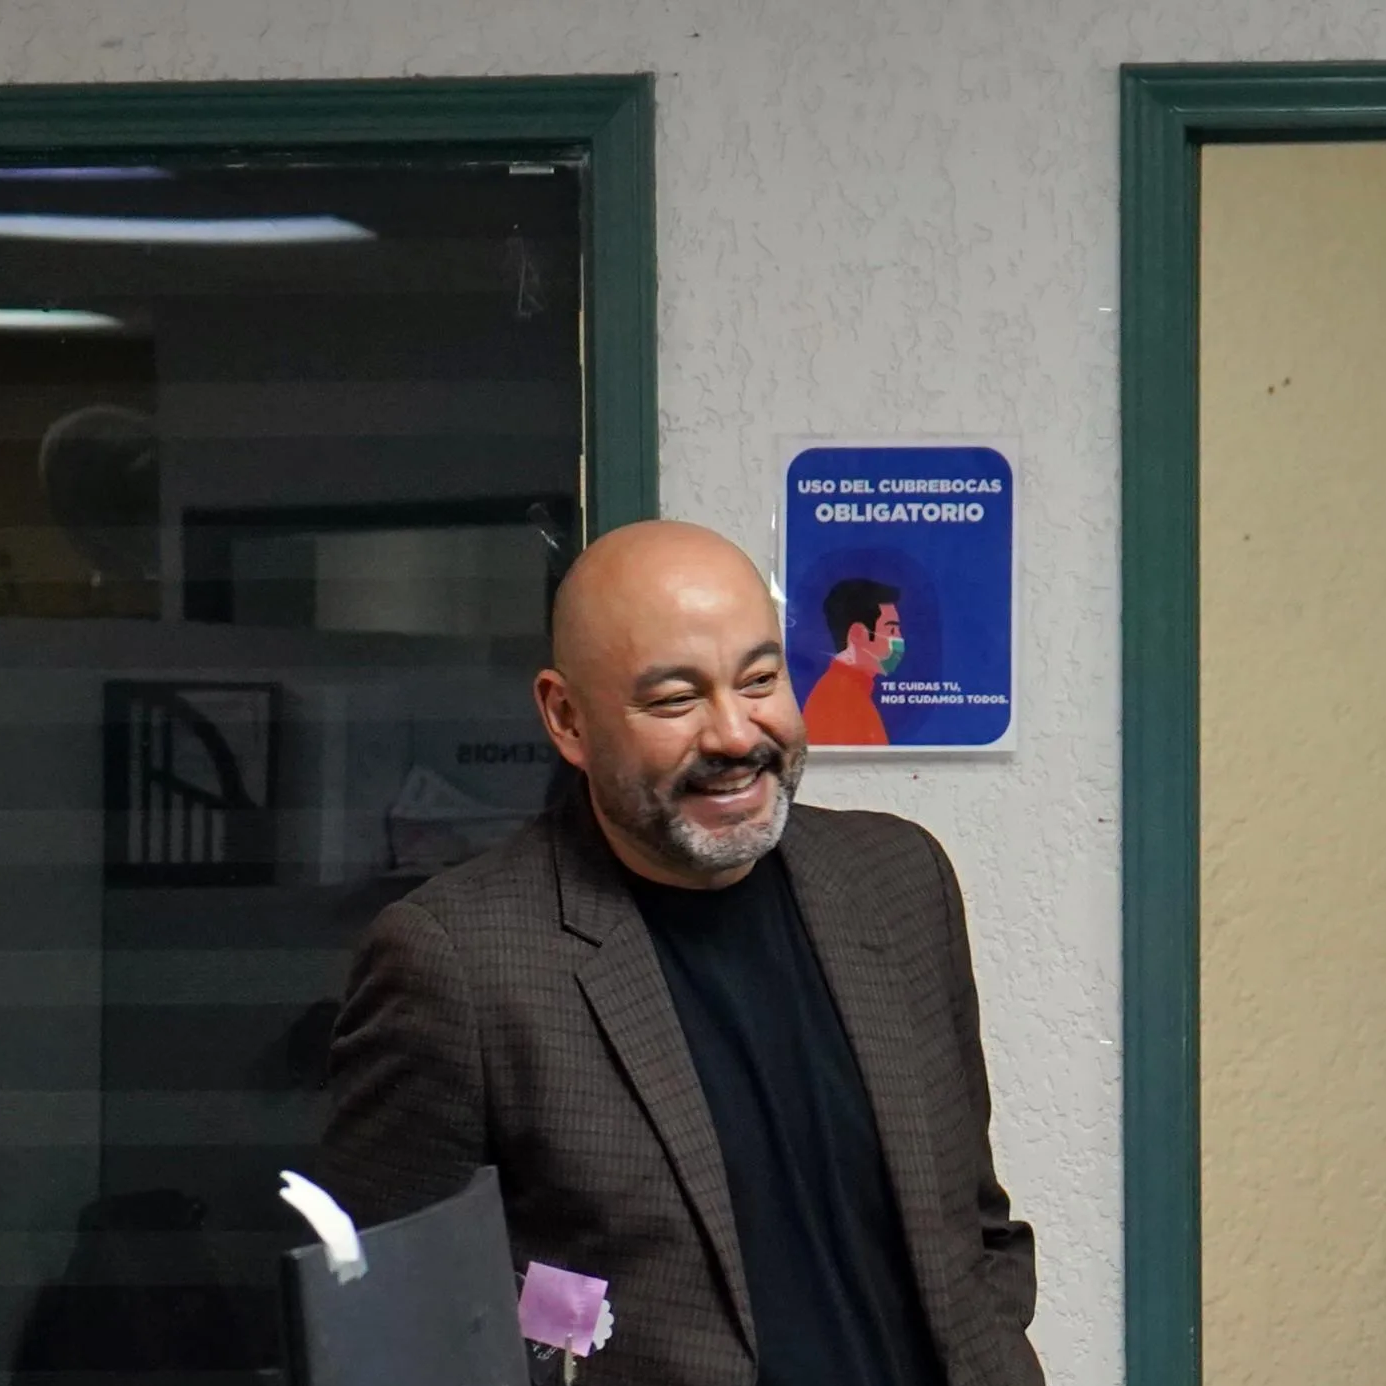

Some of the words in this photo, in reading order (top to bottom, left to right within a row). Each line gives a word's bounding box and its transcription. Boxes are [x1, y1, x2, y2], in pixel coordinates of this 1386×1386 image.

[797, 479, 836, 494] USO
[839, 479, 875, 494] DEL
[878, 478, 1002, 494] CUBREBOCAS
[814, 502, 985, 523] OBLIGATORIO
[881, 681, 896, 691] TE
[898, 681, 940, 691] CUIDAS
[881, 694, 906, 704] NOS
[966, 694, 1009, 704] TODOS.
